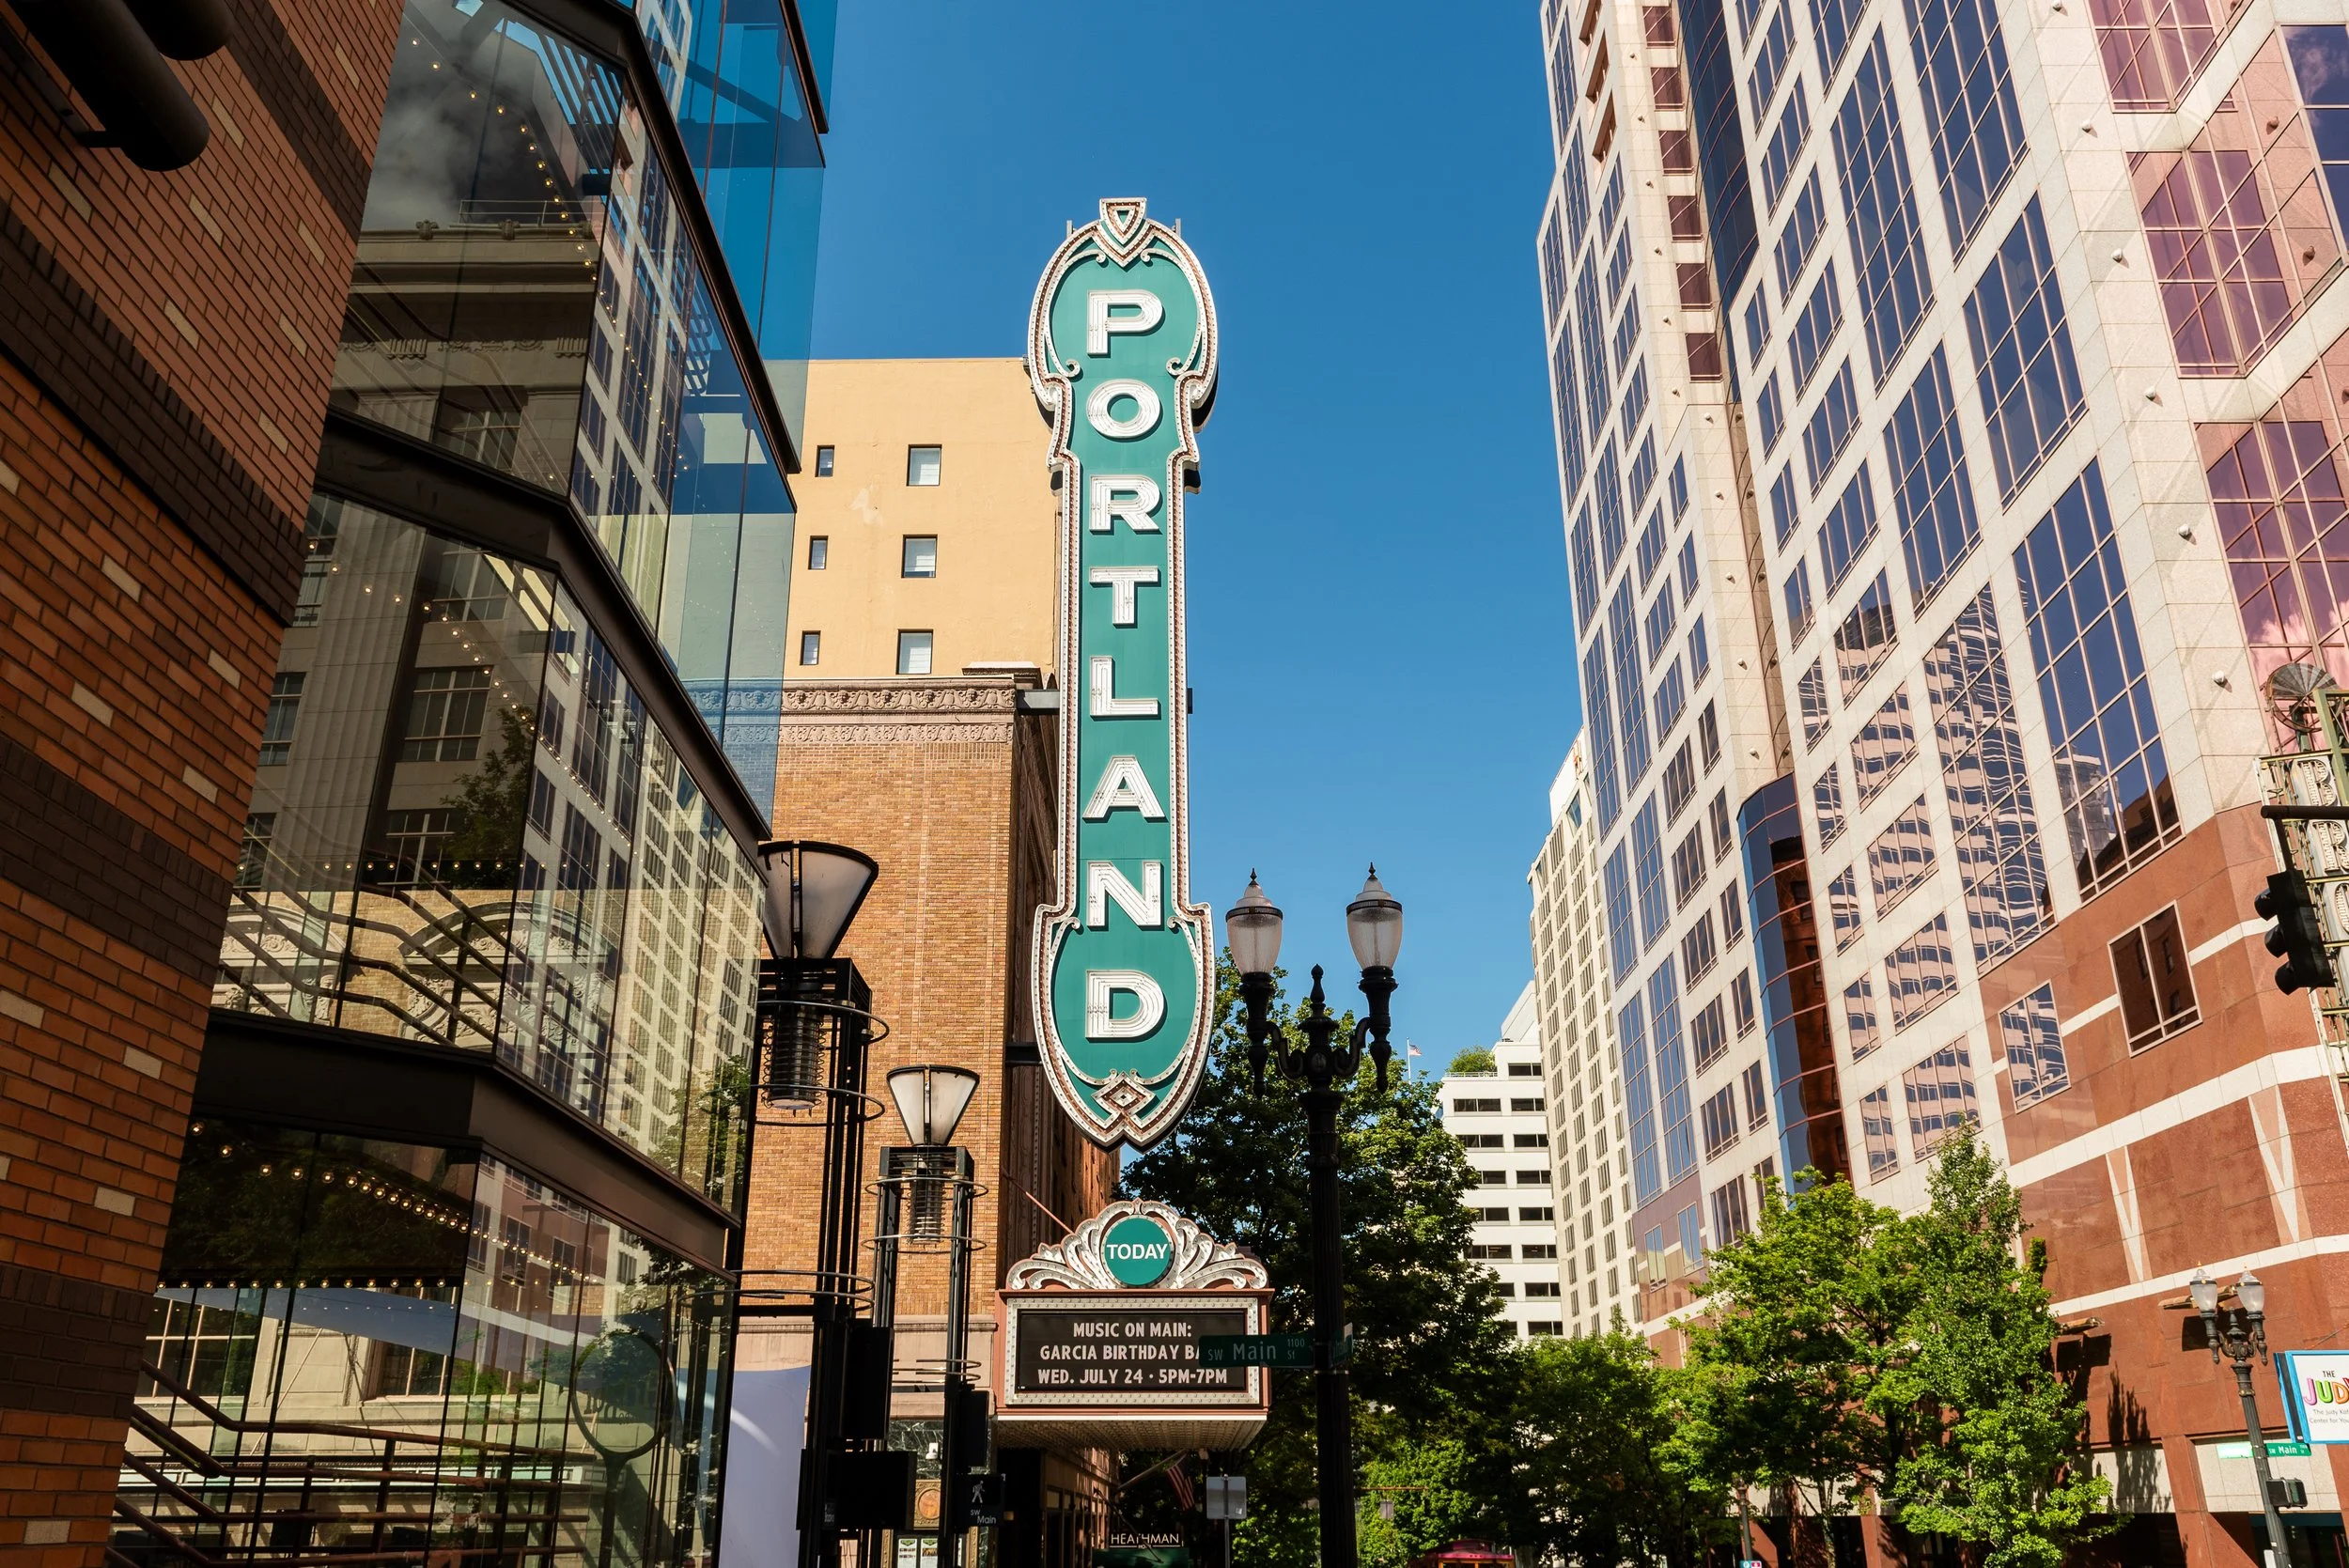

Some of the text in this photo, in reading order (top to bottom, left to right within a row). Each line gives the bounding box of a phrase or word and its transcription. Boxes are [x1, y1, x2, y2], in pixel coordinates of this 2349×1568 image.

[1082, 289, 1165, 1039] PORTLAND
[1106, 1243, 1168, 1260] TODAY
[1073, 1322, 1192, 1338] MUSIC ON MAIN:
[1207, 1341, 1296, 1361] SW Main St
[1287, 1338, 1305, 1348] 1100
[1040, 1344, 1097, 1361] GARCIA
[1102, 1344, 1179, 1361] BIRTHDAY
[1038, 1369, 1228, 1385] WED. JULY 24 5PM-7PM
[2323, 1370, 2336, 1378] THE
[2278, 1446, 2297, 1454] Main
[976, 1515, 997, 1525] Main
